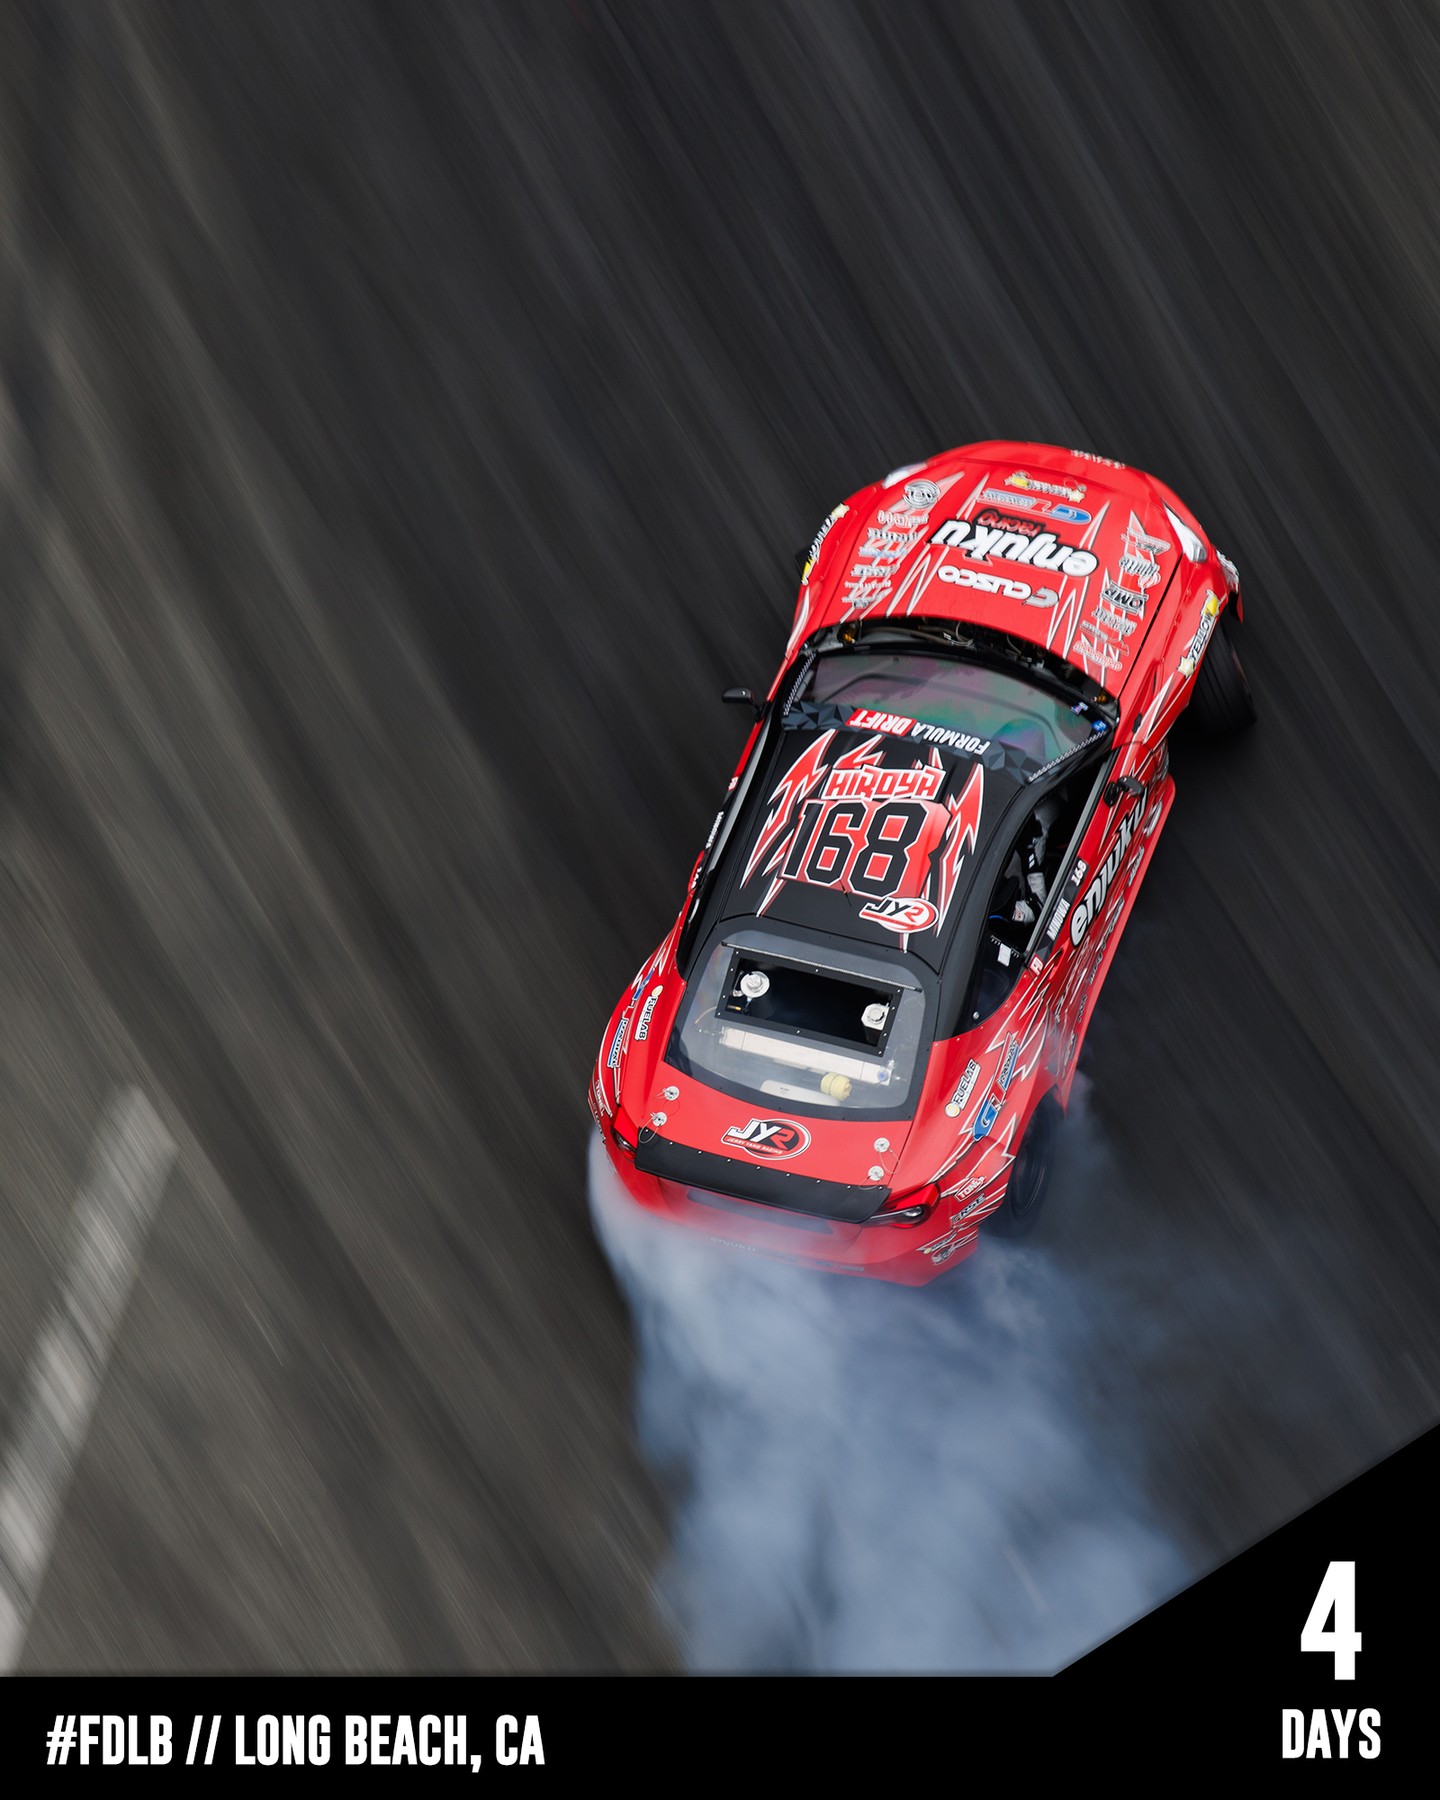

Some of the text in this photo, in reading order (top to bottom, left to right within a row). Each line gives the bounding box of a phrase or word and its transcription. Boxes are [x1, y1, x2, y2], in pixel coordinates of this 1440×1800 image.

[978, 511, 1041, 536] racing
[931, 520, 1098, 577] enjuku
[938, 565, 1032, 600] cusco
[849, 710, 990, 755] FORMULA DRIFT
[823, 765, 945, 800] HIROYA
[782, 799, 928, 898] 168
[1070, 787, 1148, 947] enjuku
[1071, 860, 1087, 886] 168
[866, 898, 921, 921] JYR
[1046, 898, 1071, 941] MINOWA
[1030, 956, 1043, 975] FD
[638, 997, 656, 1039] FUELAB
[952, 1059, 976, 1104] FUELAB
[727, 1120, 795, 1149] JYR
[727, 1137, 745, 1145] JERRY
[761, 1146, 782, 1154] RACING
